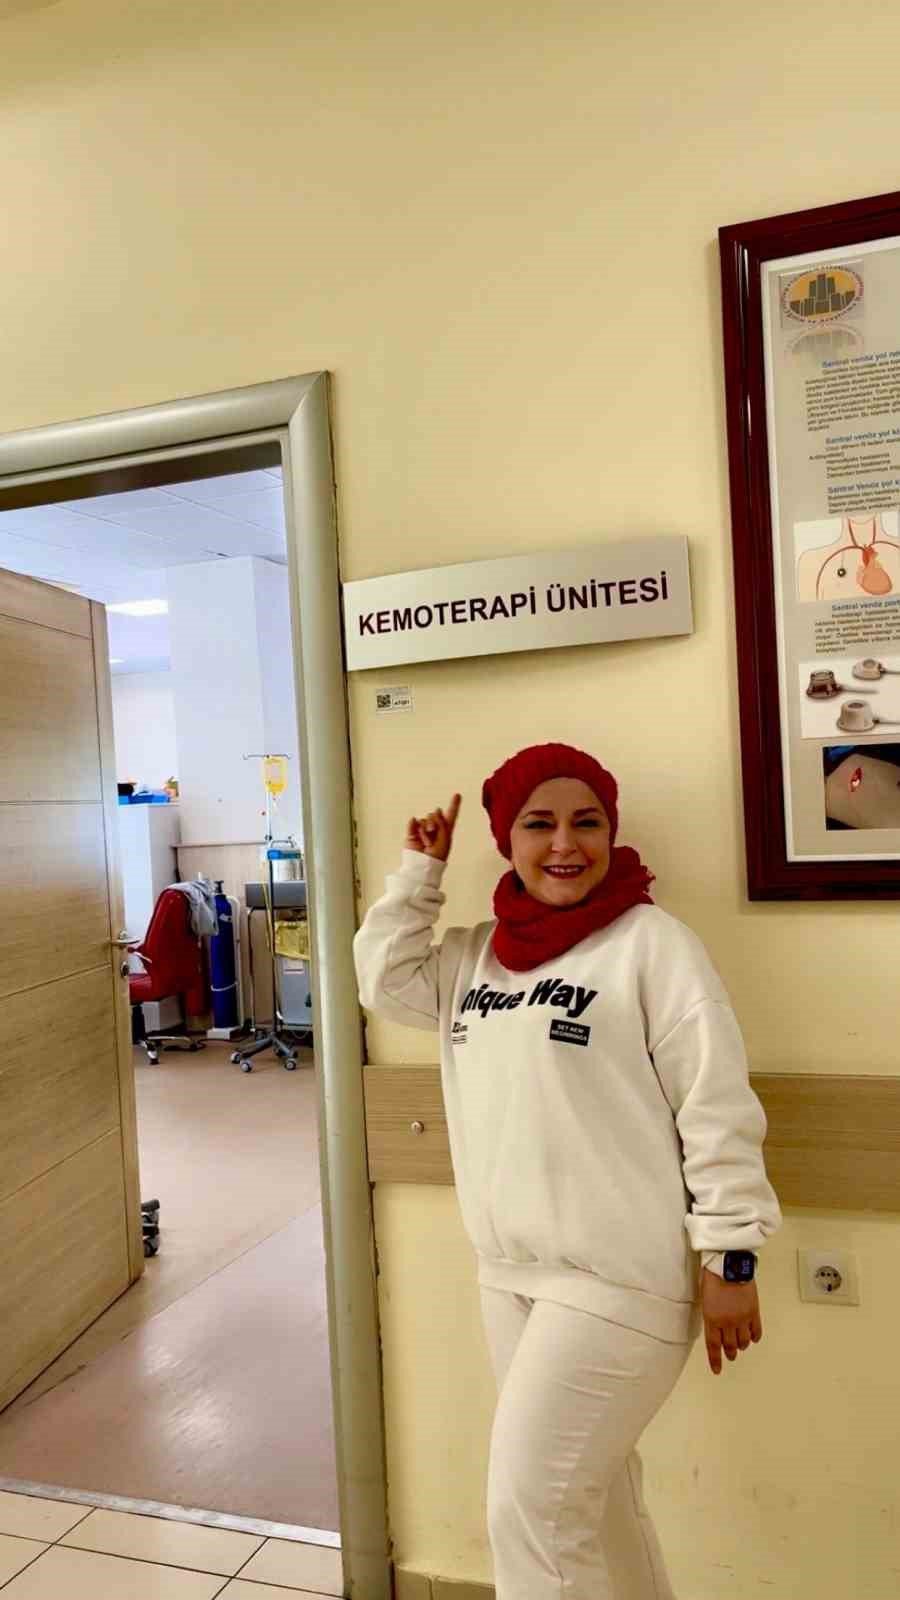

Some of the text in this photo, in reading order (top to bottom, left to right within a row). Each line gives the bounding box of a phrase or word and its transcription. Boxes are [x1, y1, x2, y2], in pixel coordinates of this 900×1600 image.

[359, 571, 669, 636] KEMOTERAPİ ÜNİTESİ
[528, 978, 598, 1018] Way
